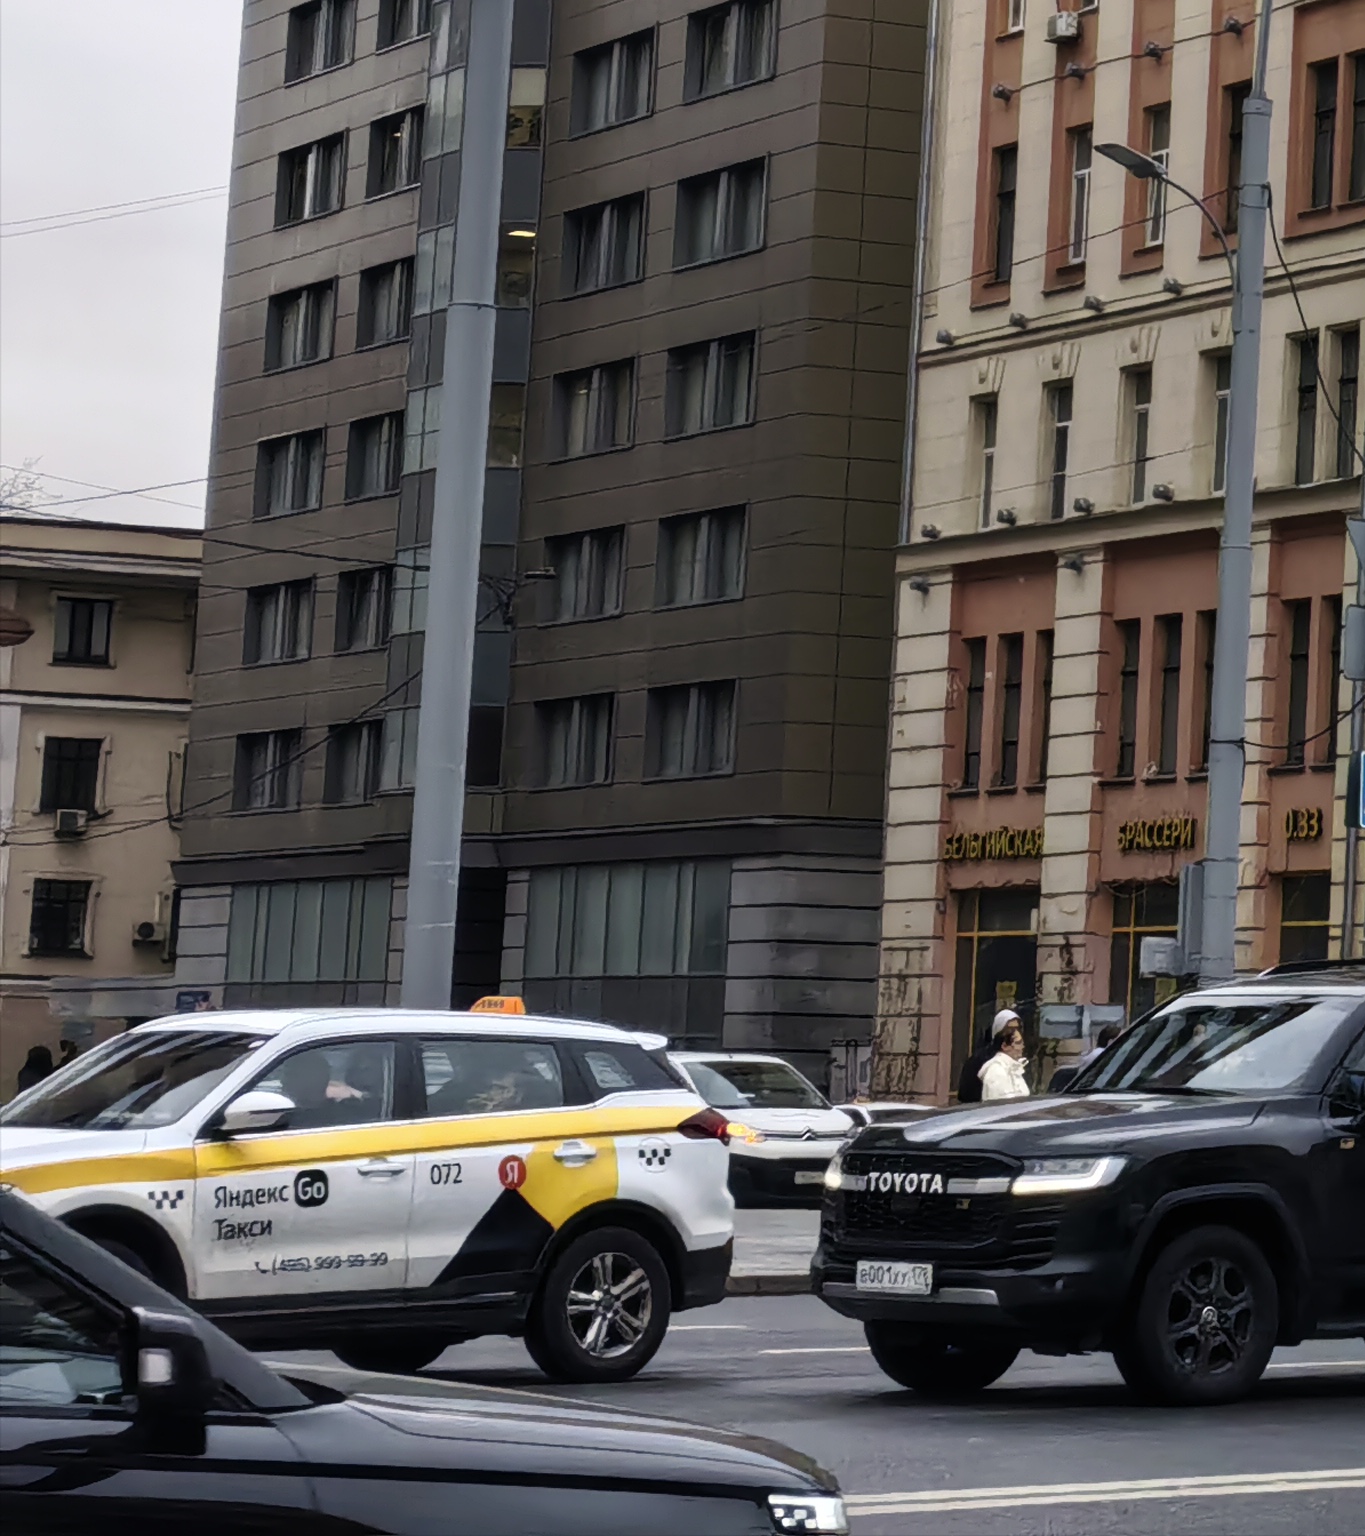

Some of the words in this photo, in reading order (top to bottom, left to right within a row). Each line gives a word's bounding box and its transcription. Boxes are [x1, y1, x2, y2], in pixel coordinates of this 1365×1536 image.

[943, 826, 1044, 859] БЕЛЬГИЙСКАЯ
[1117, 817, 1196, 850] БРАССЕРИ
[430, 1163, 462, 1185] 072
[868, 1171, 943, 1194] TOYOTA
[214, 1184, 289, 1209] Яндекс
[297, 1175, 327, 1202] Go
[213, 1216, 272, 1241] Такси
